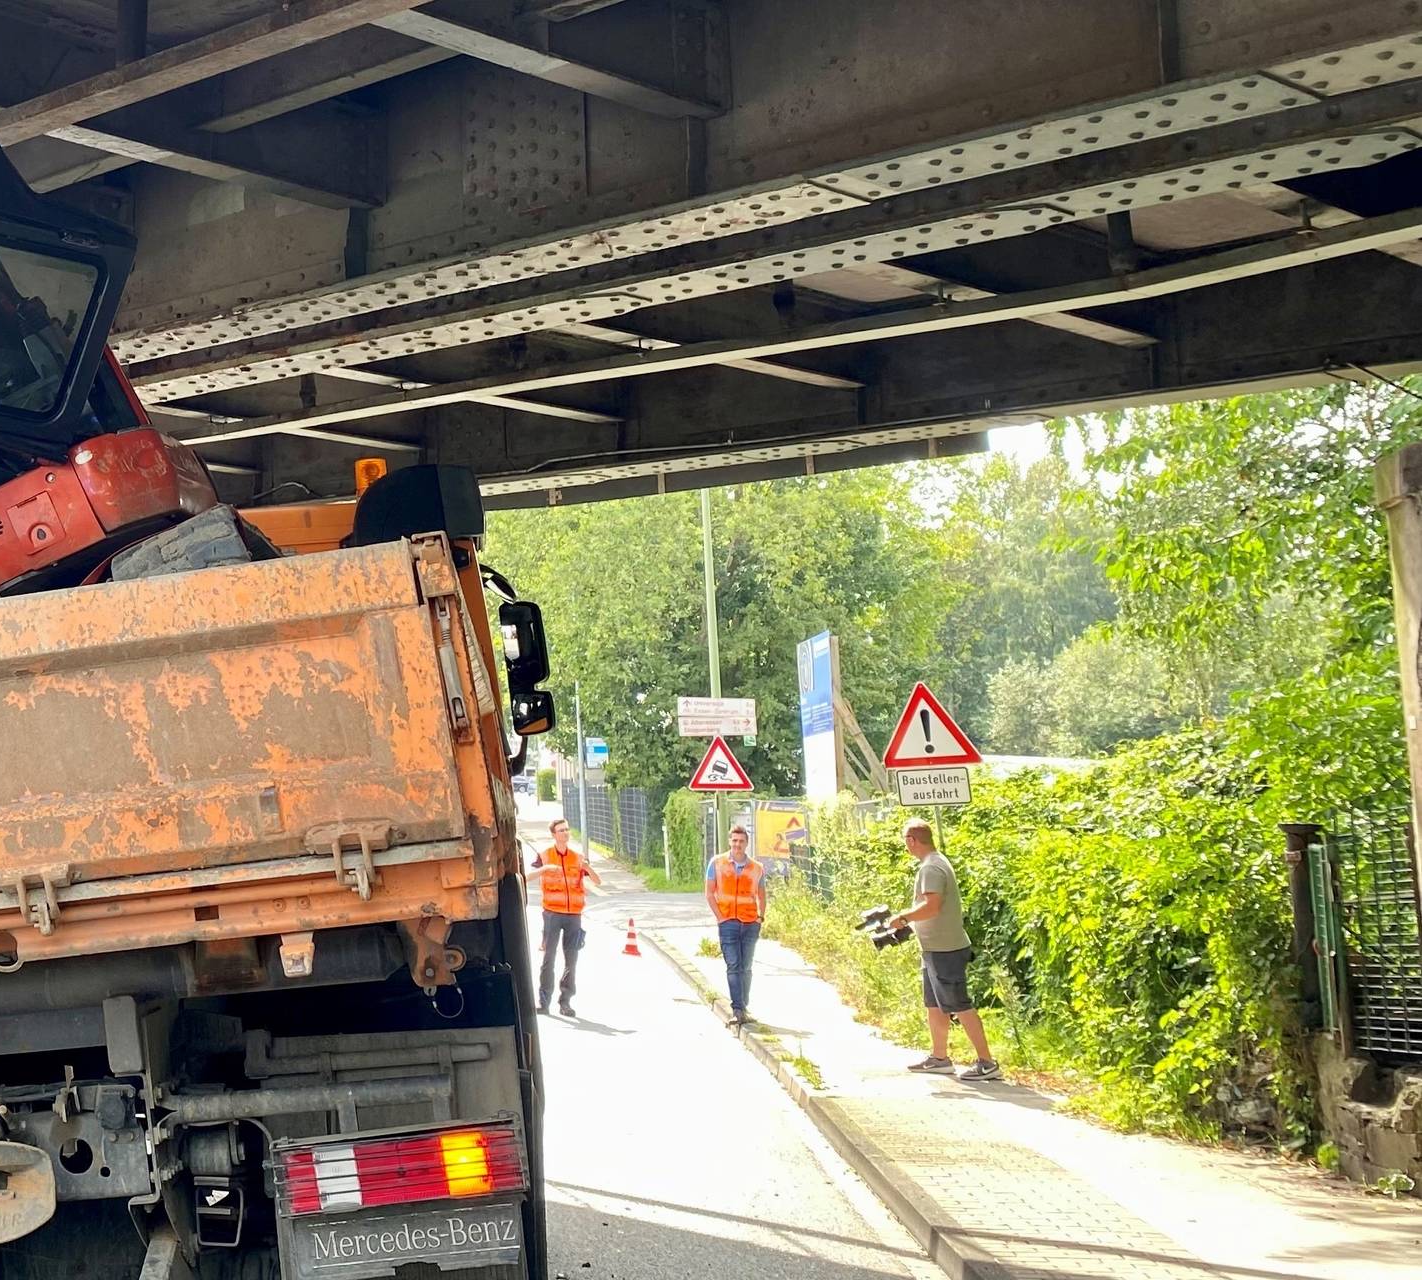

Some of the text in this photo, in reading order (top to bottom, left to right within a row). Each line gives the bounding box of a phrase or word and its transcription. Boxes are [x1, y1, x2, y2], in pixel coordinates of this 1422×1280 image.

[902, 773, 966, 786] Baustellen-
[913, 787, 960, 800] ausfahrt
[313, 1217, 516, 1260] Mercedes-Benz
